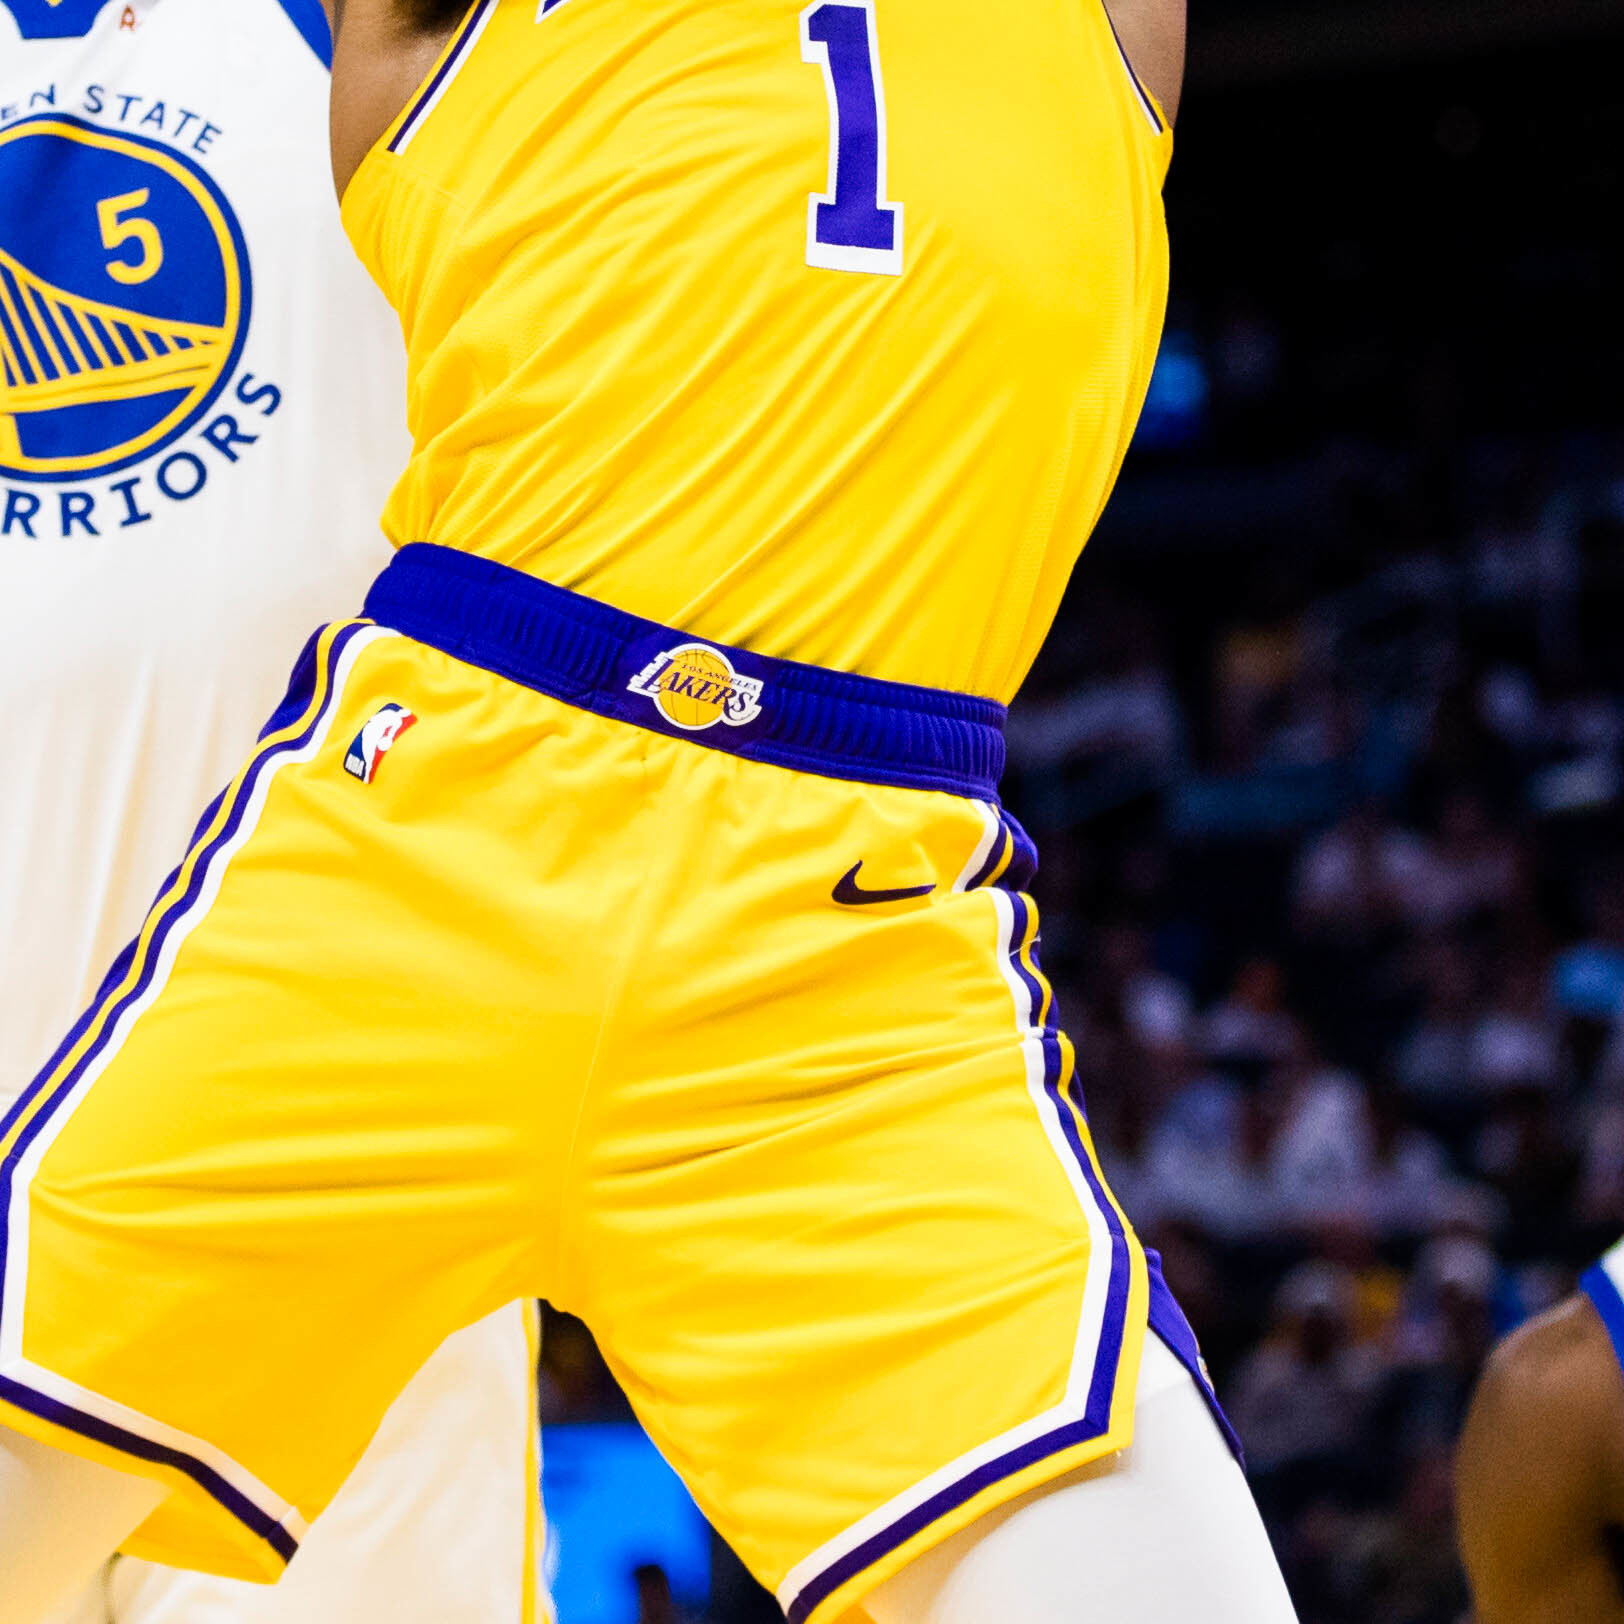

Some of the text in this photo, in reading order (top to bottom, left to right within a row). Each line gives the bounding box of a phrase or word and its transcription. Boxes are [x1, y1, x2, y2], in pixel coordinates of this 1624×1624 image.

[84, 85, 222, 156] STATE
[96, 188, 164, 286] 5
[636, 657, 756, 721] LAKERS
